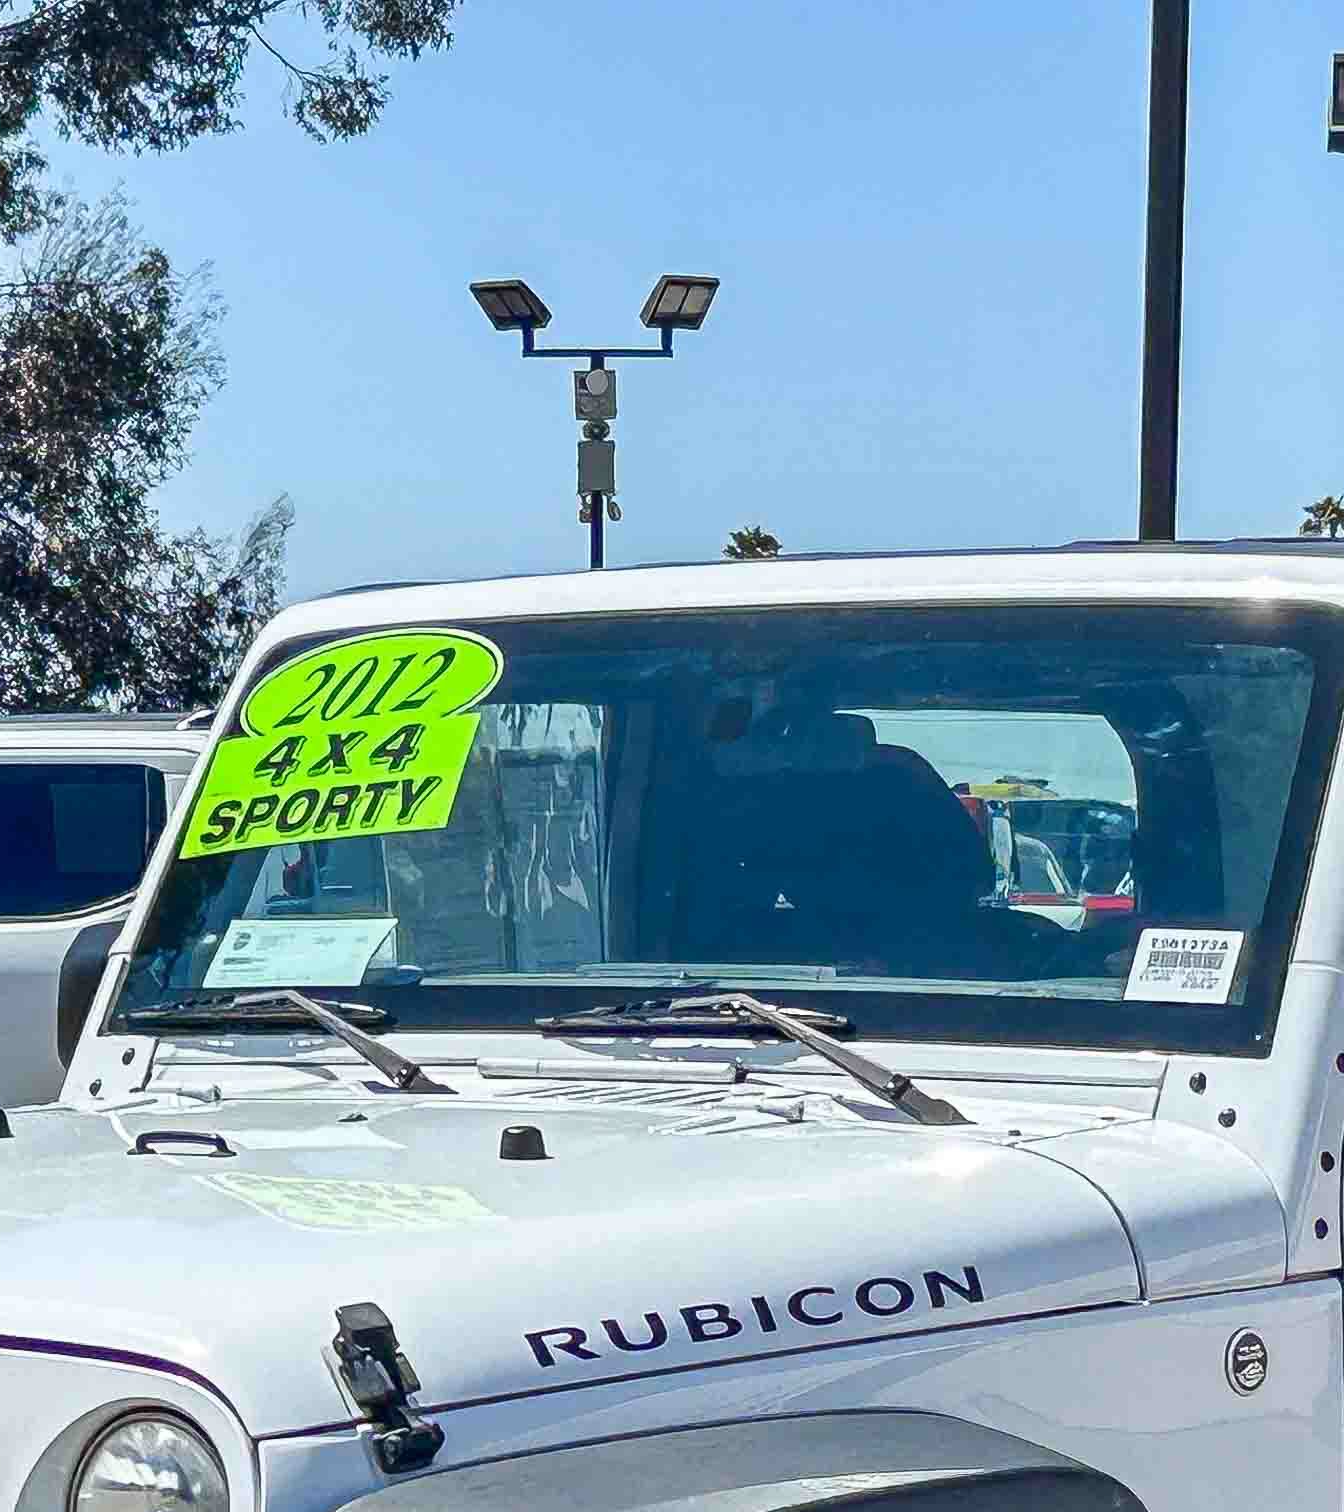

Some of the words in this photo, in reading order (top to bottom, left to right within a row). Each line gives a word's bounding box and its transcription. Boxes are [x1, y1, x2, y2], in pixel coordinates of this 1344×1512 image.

[272, 647, 457, 728] 2012
[199, 776, 442, 849] SPORTY
[523, 1265, 985, 1368] RUBICON
